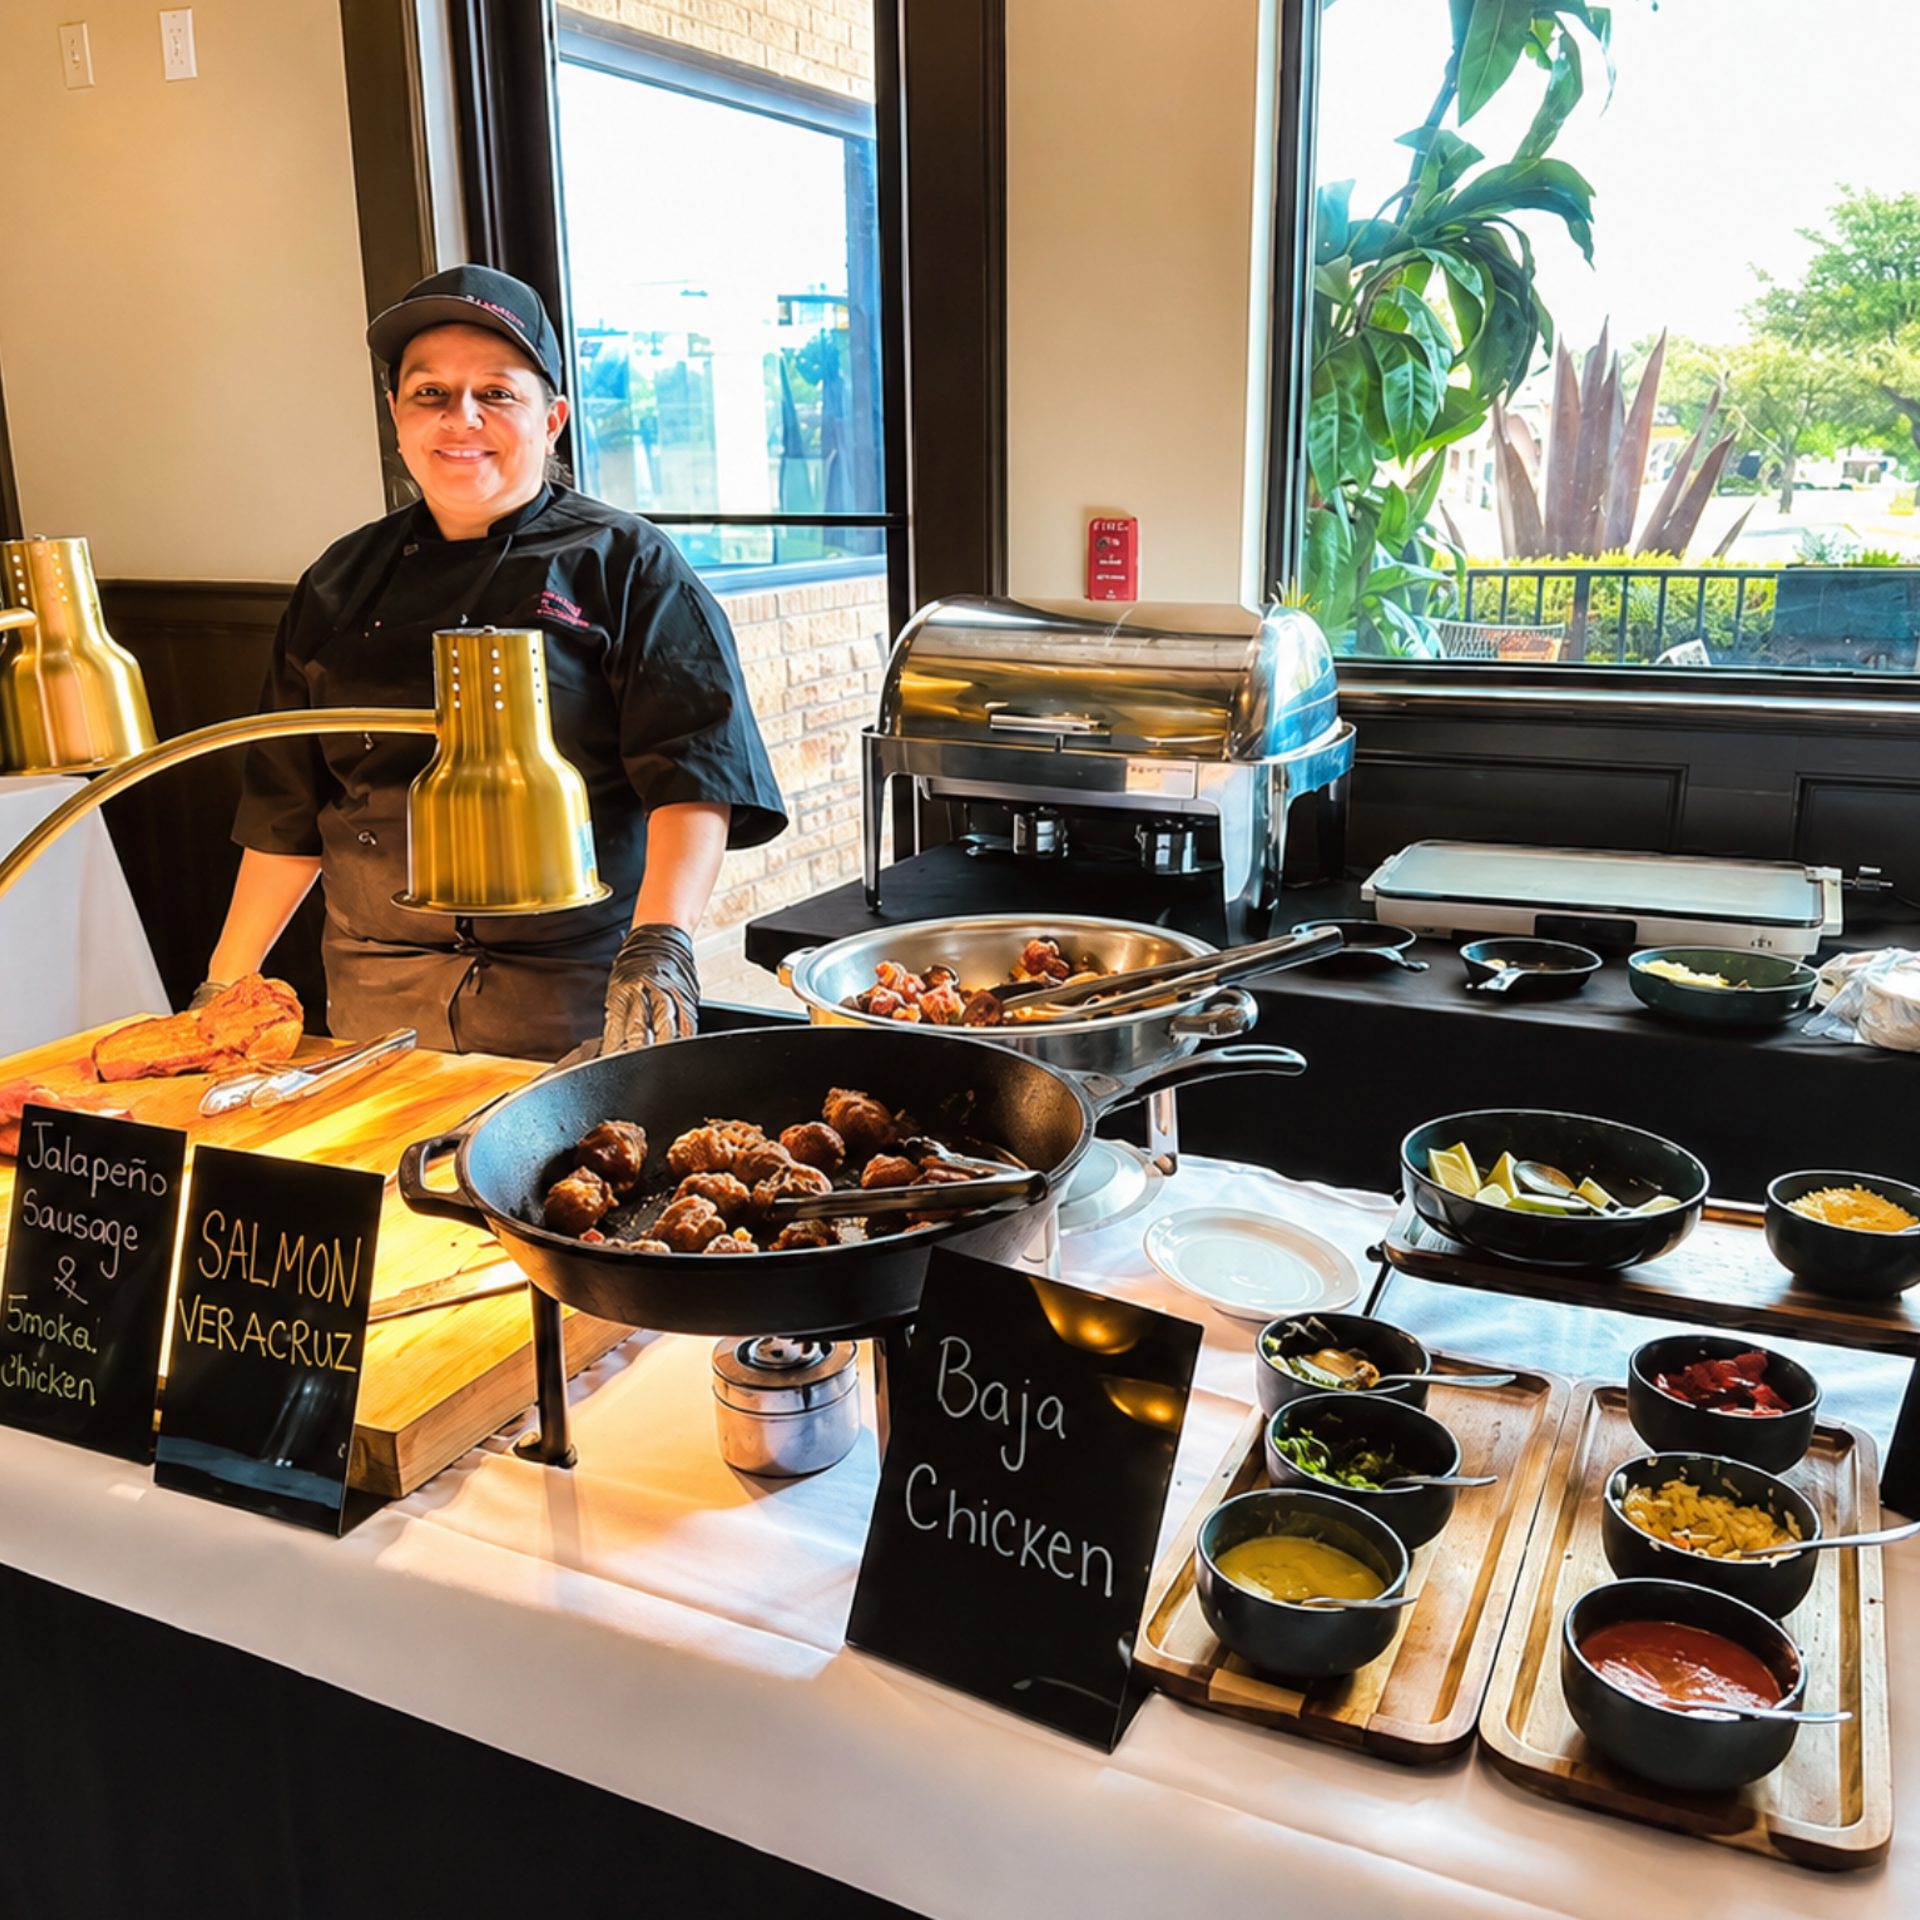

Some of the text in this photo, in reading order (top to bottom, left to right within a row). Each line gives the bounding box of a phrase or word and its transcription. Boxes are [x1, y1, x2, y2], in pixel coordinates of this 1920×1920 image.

[27, 1121, 168, 1198] Jalapeño
[22, 1188, 140, 1279] Sausage
[197, 1209, 363, 1309] SALMON
[178, 1295, 358, 1373] VERACRUZ
[0, 1353, 97, 1407] Chicken
[937, 1335, 1066, 1472] Baja
[905, 1463, 1114, 1599] Chicken
